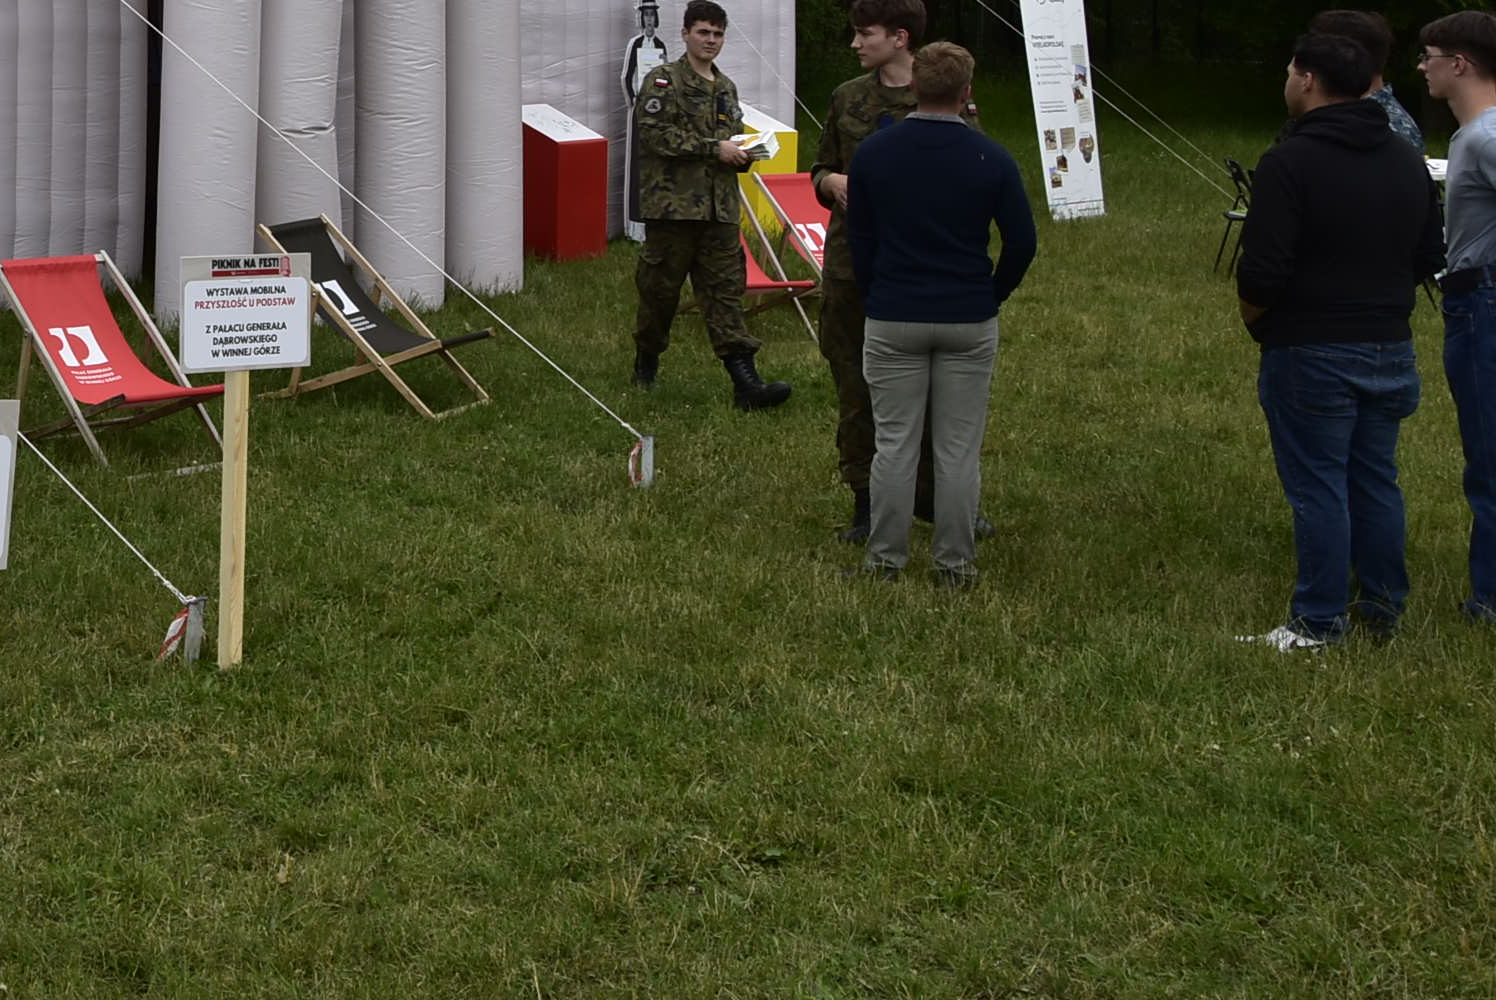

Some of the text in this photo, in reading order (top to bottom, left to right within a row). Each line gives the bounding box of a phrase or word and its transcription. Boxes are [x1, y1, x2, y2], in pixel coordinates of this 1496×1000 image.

[212, 259, 242, 269] PIKNIK
[243, 259, 257, 268] NA
[206, 286, 287, 297] WYSTAWA MOBILNA
[194, 298, 296, 309] PRZYSZŁOŚĆ U PODSTAW
[206, 322, 287, 334] Z PAŁACU GENERAŁA
[213, 334, 278, 347] DĄBROWSKIEGO
[211, 344, 281, 358] W WINNEJ GÓRZE
